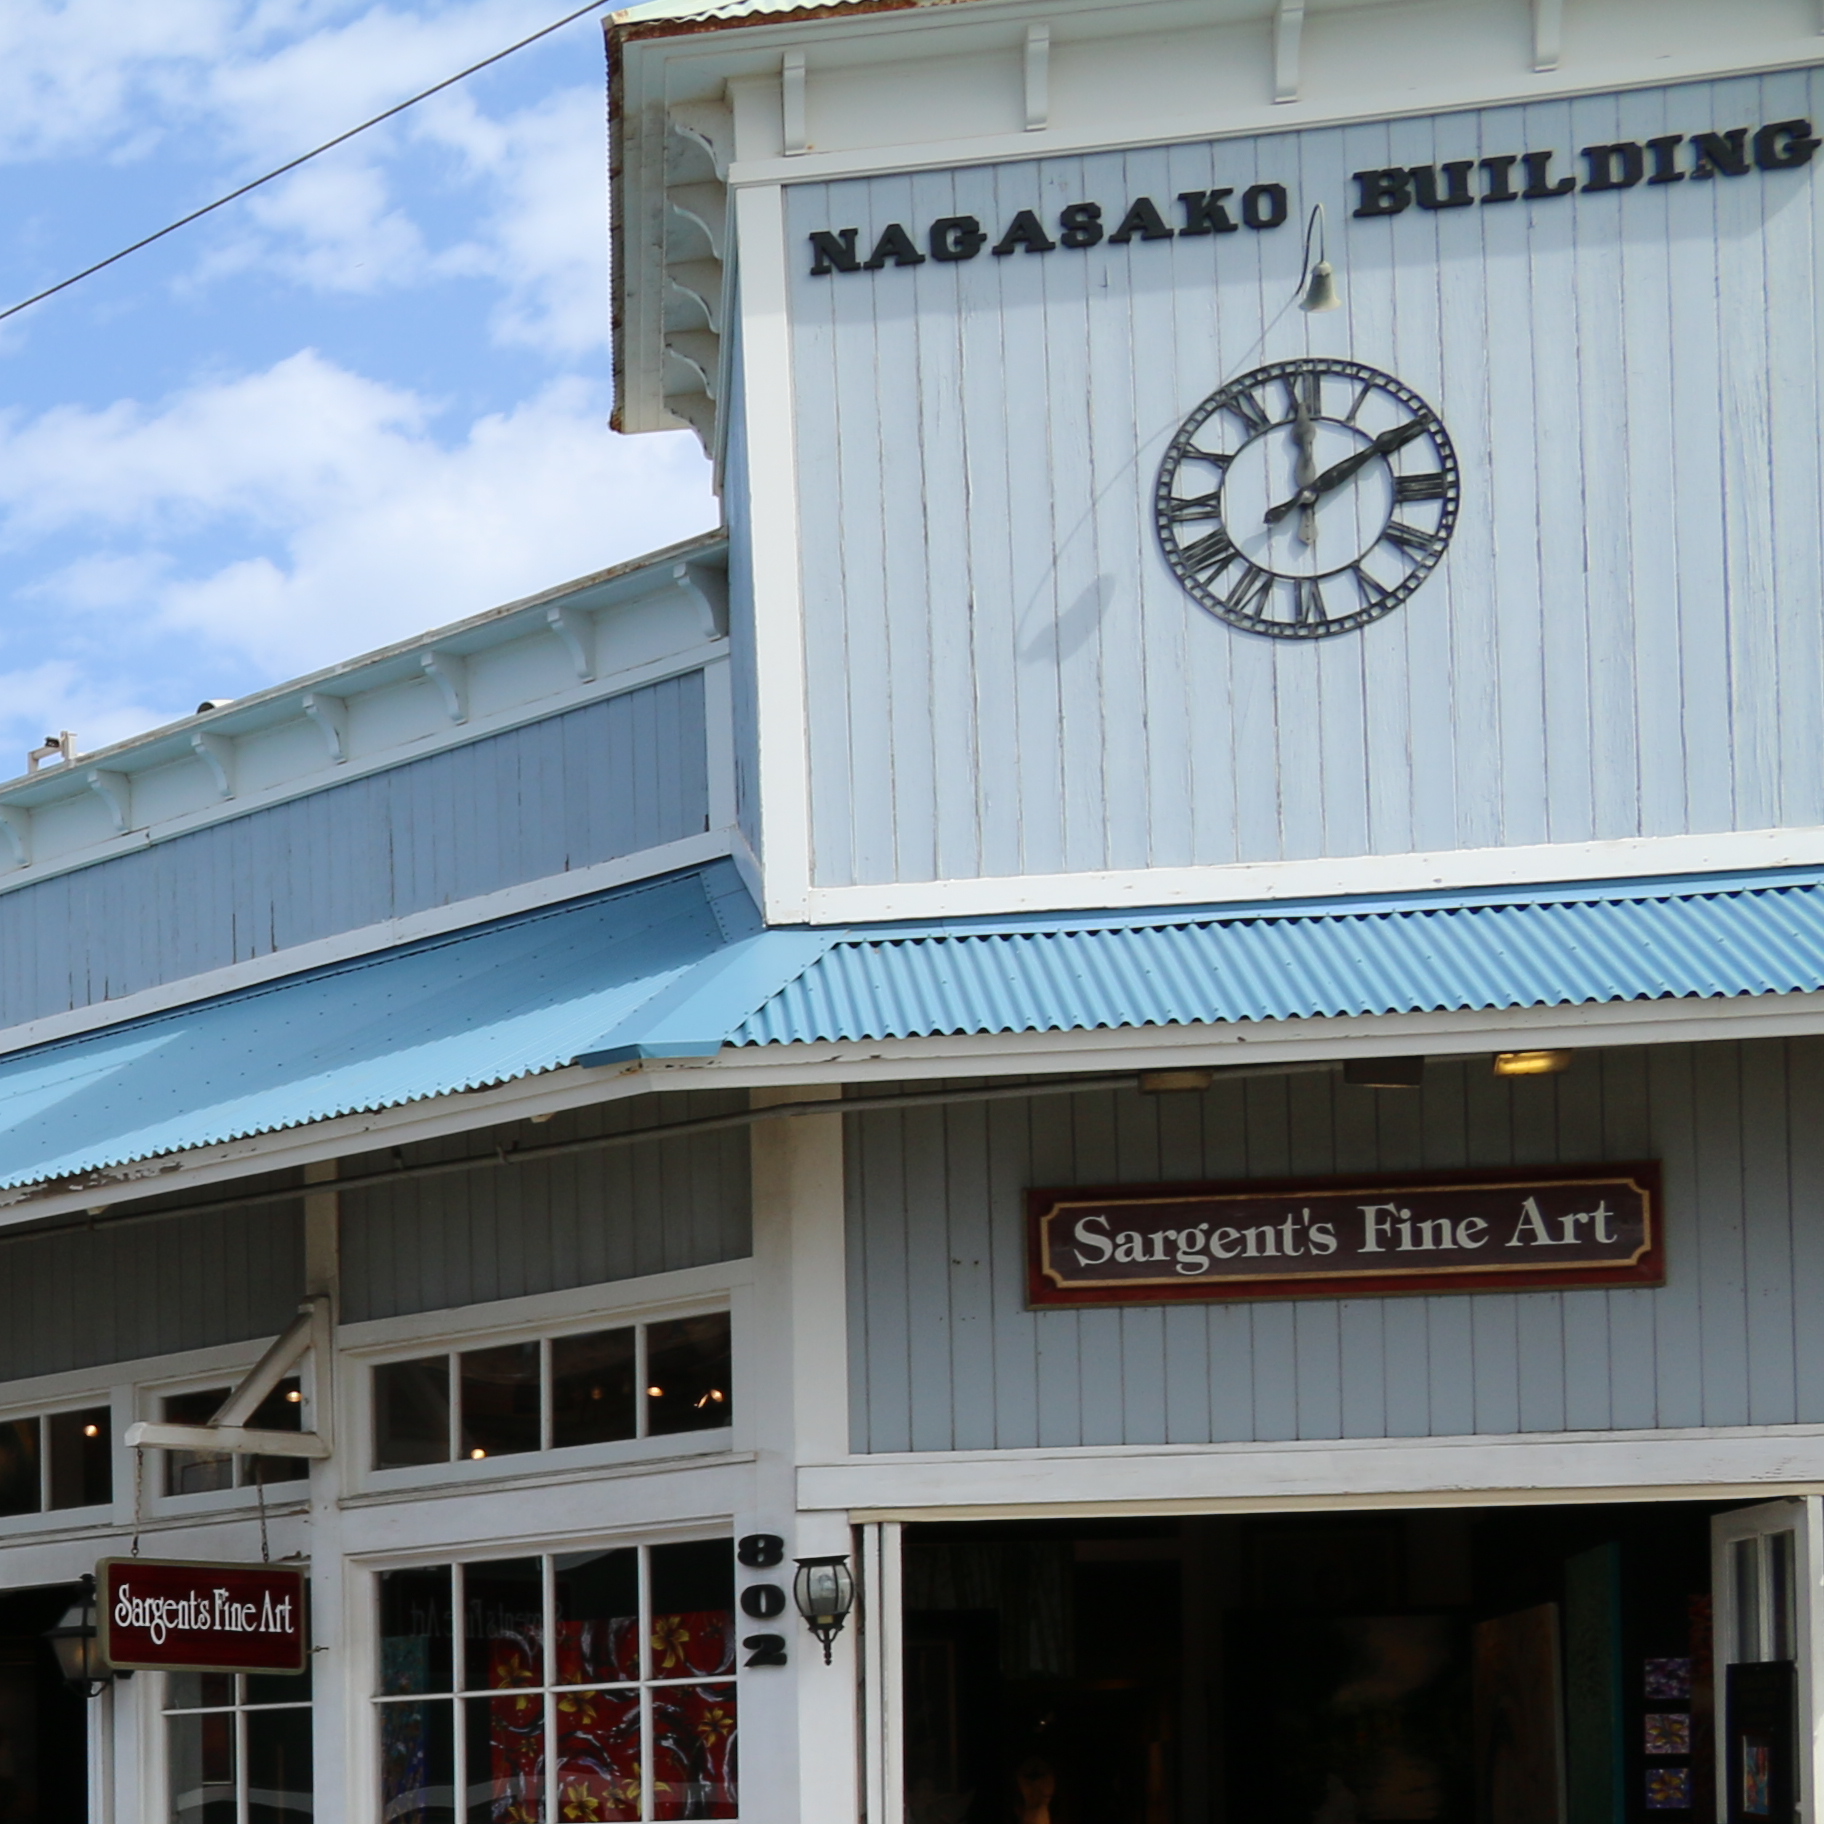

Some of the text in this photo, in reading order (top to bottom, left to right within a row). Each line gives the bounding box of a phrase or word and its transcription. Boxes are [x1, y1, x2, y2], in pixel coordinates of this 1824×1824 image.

[809, 117, 1821, 275] NAGASAKO BUILDING
[1178, 441, 1235, 470] X
[1394, 472, 1444, 502] III
[1295, 577, 1328, 624] VI
[1353, 563, 1394, 606] V
[1073, 1196, 1618, 1275] Sargent's Fine Art
[115, 1584, 294, 1644] Sargent's Fine Art
[737, 1534, 788, 1668] 802
